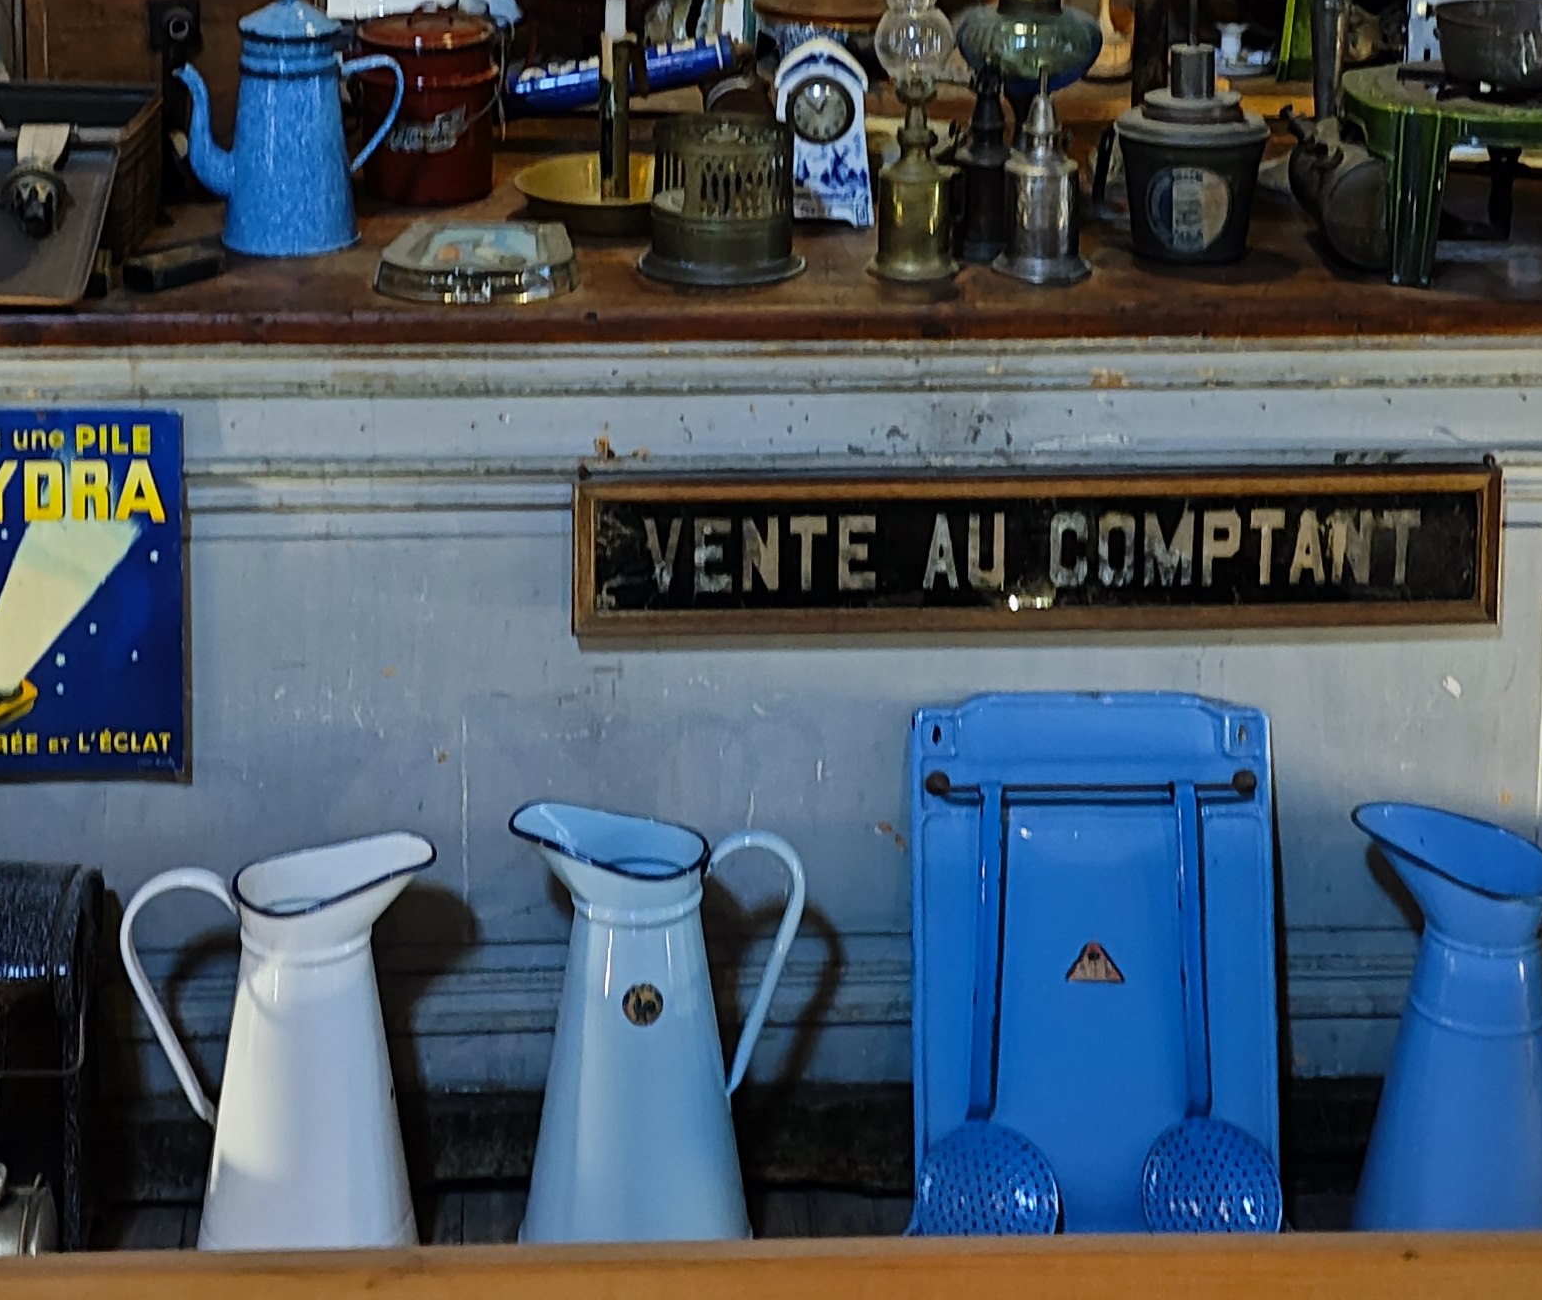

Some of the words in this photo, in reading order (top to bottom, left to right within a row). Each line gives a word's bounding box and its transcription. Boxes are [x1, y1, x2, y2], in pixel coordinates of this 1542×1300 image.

[13, 428, 66, 452] une
[75, 423, 152, 456] PILE
[642, 511, 880, 595] VENTE
[922, 510, 1007, 593] AU
[1047, 507, 1423, 591] COMPTANT
[48, 736, 71, 755] ET
[77, 727, 172, 756] L'ÉCLAT
